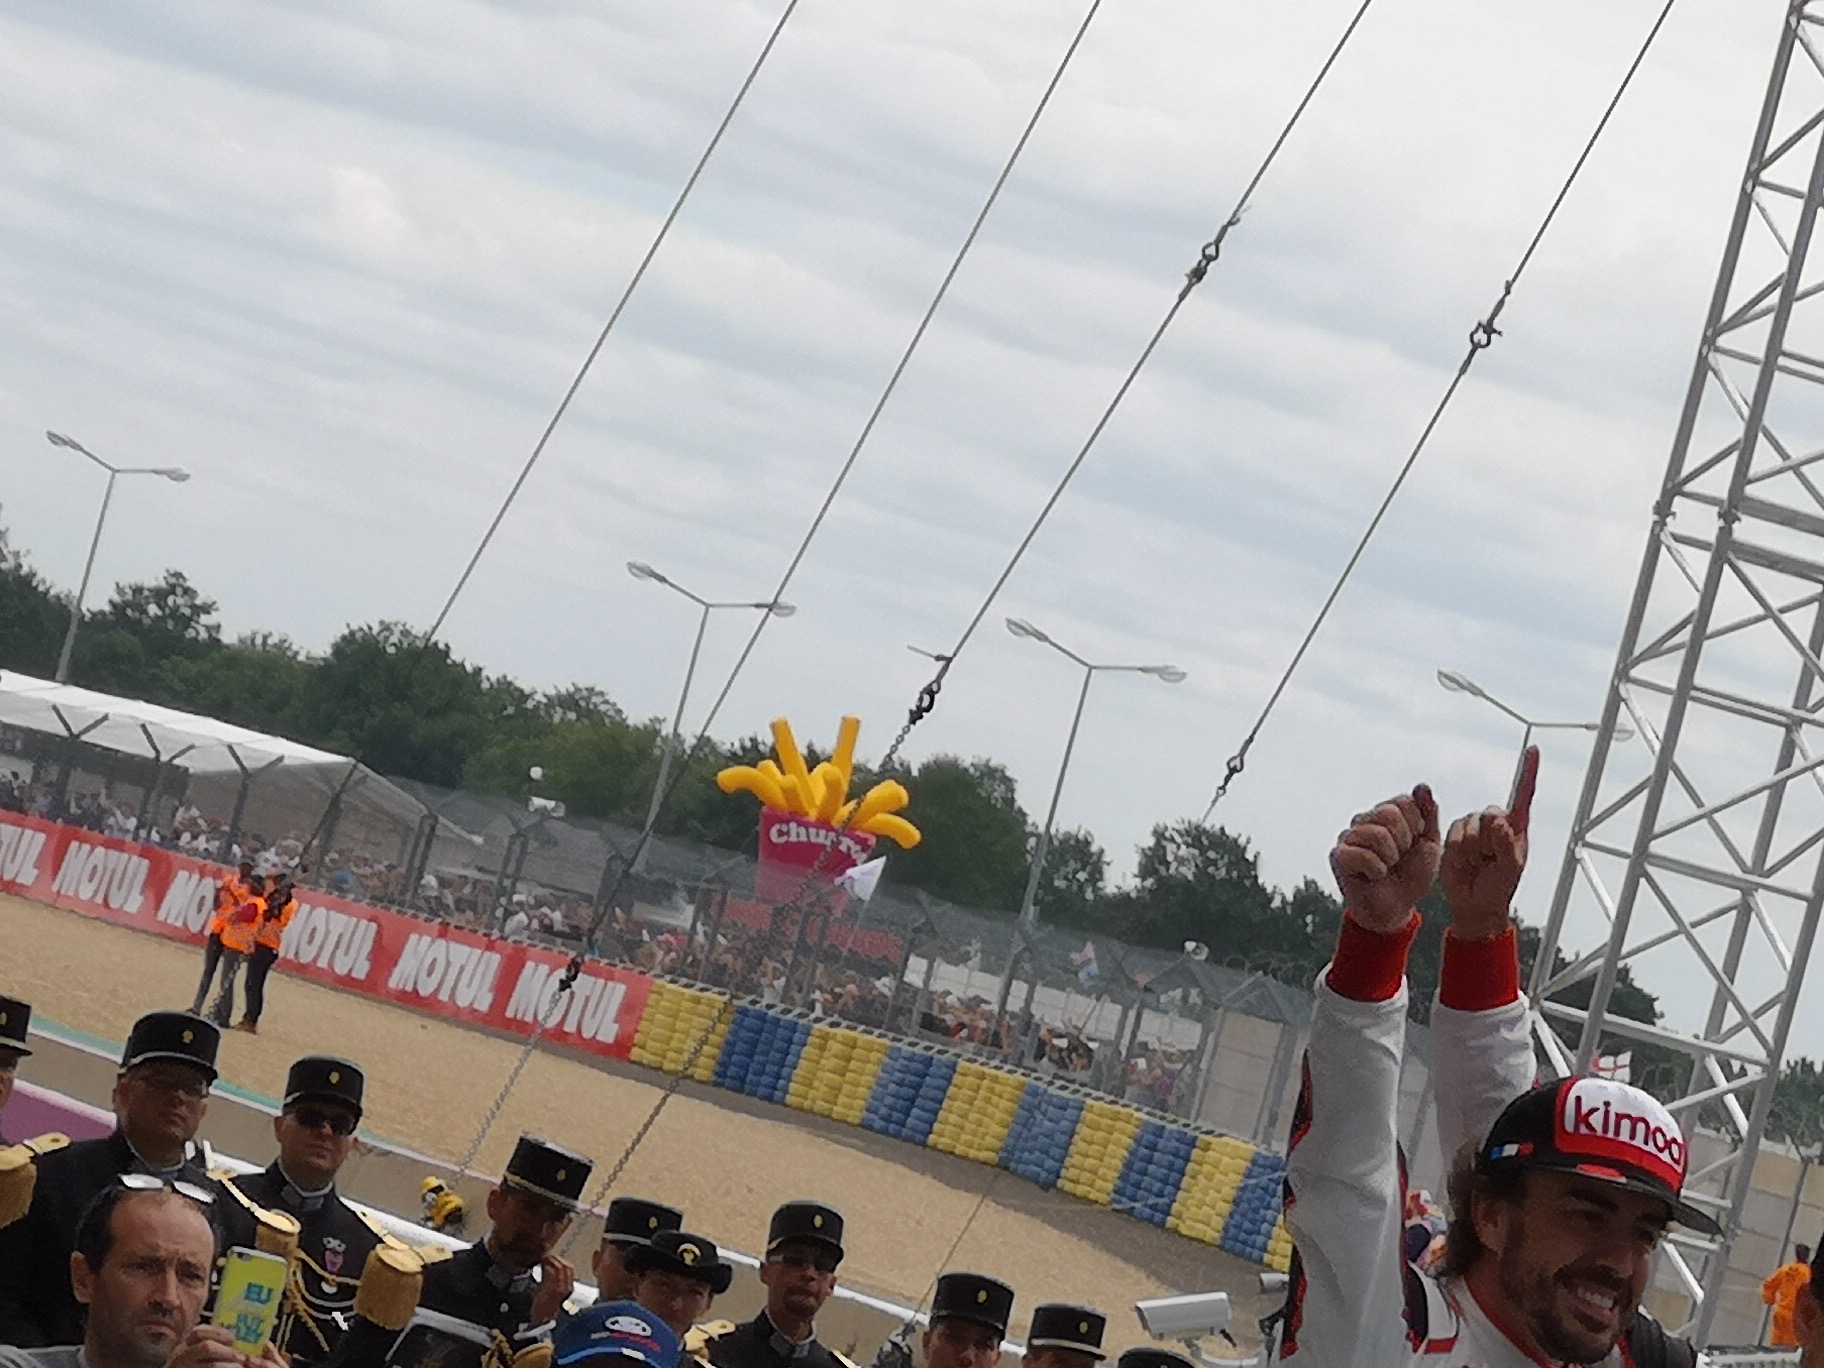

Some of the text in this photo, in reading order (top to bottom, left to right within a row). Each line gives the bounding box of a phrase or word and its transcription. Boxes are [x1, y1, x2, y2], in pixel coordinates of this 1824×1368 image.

[0, 821, 46, 887] TUL
[51, 840, 151, 915] MOTUL
[157, 869, 223, 936] MO
[388, 933, 502, 1013] MOTUL
[505, 961, 627, 1044] MOTUL
